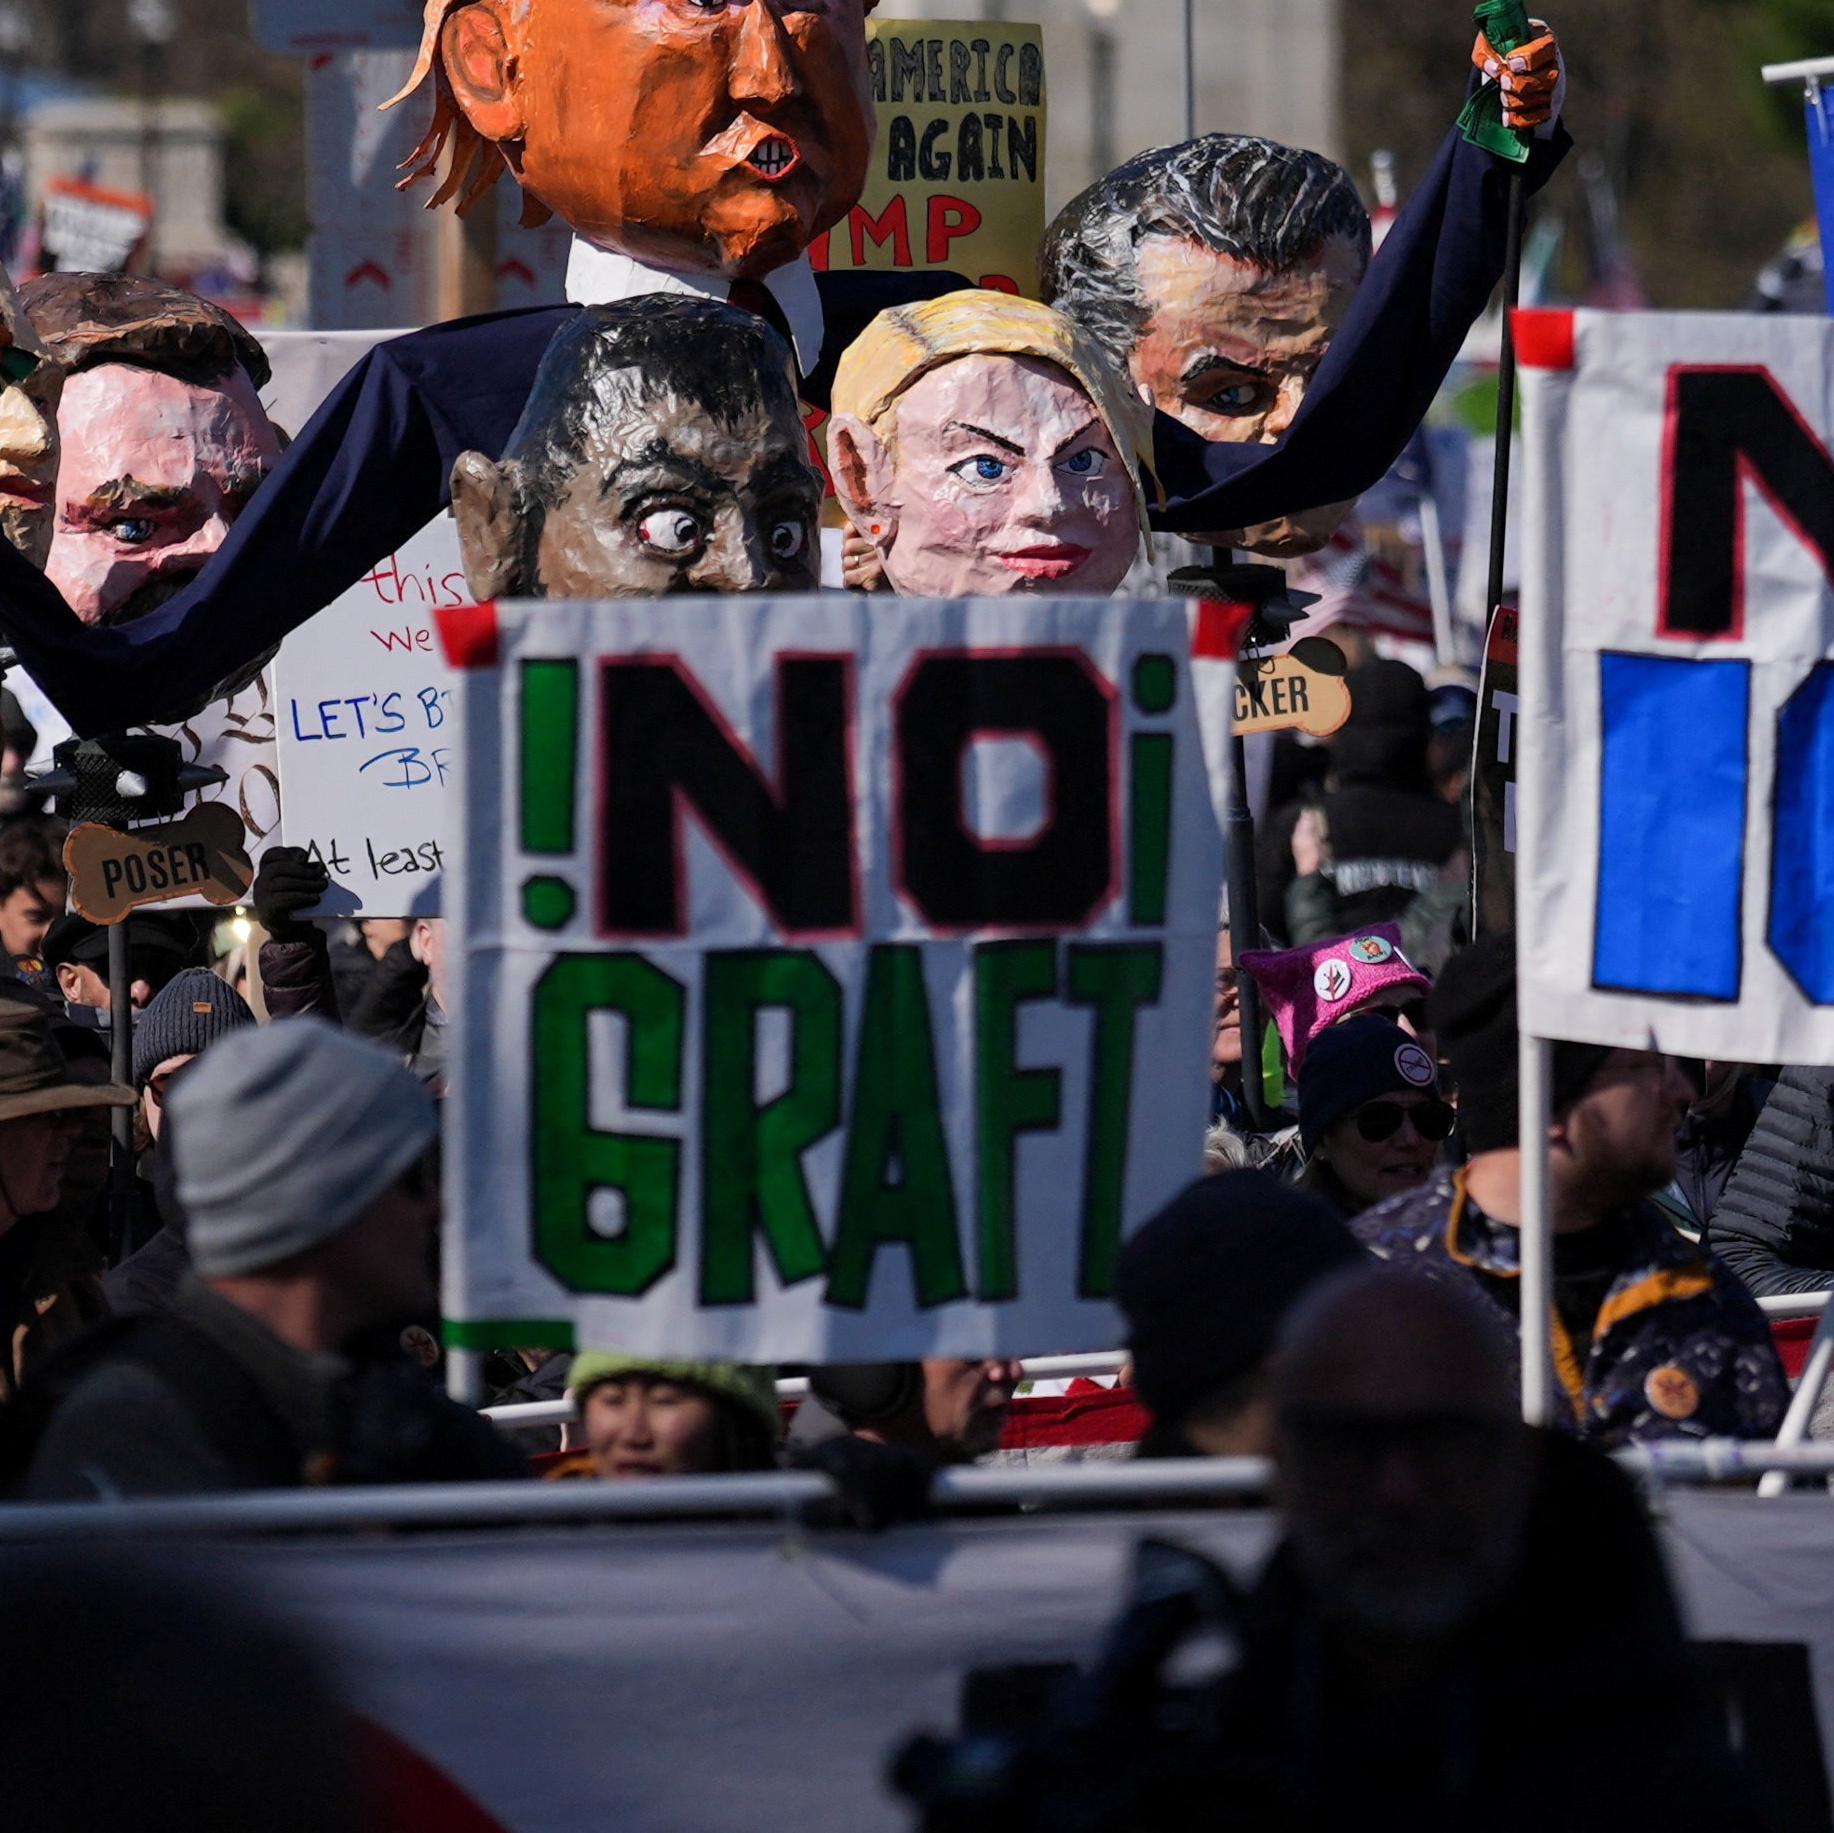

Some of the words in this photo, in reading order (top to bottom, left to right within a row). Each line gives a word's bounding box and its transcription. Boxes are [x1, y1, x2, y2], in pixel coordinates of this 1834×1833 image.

[868, 37, 1043, 107] AMERICA
[887, 111, 1038, 183] AGAIN
[361, 552, 465, 608] this
[290, 691, 405, 742] LET'S
[102, 841, 211, 899] POSER
[366, 836, 445, 881] least
[528, 939, 1166, 1310] GRAFT
